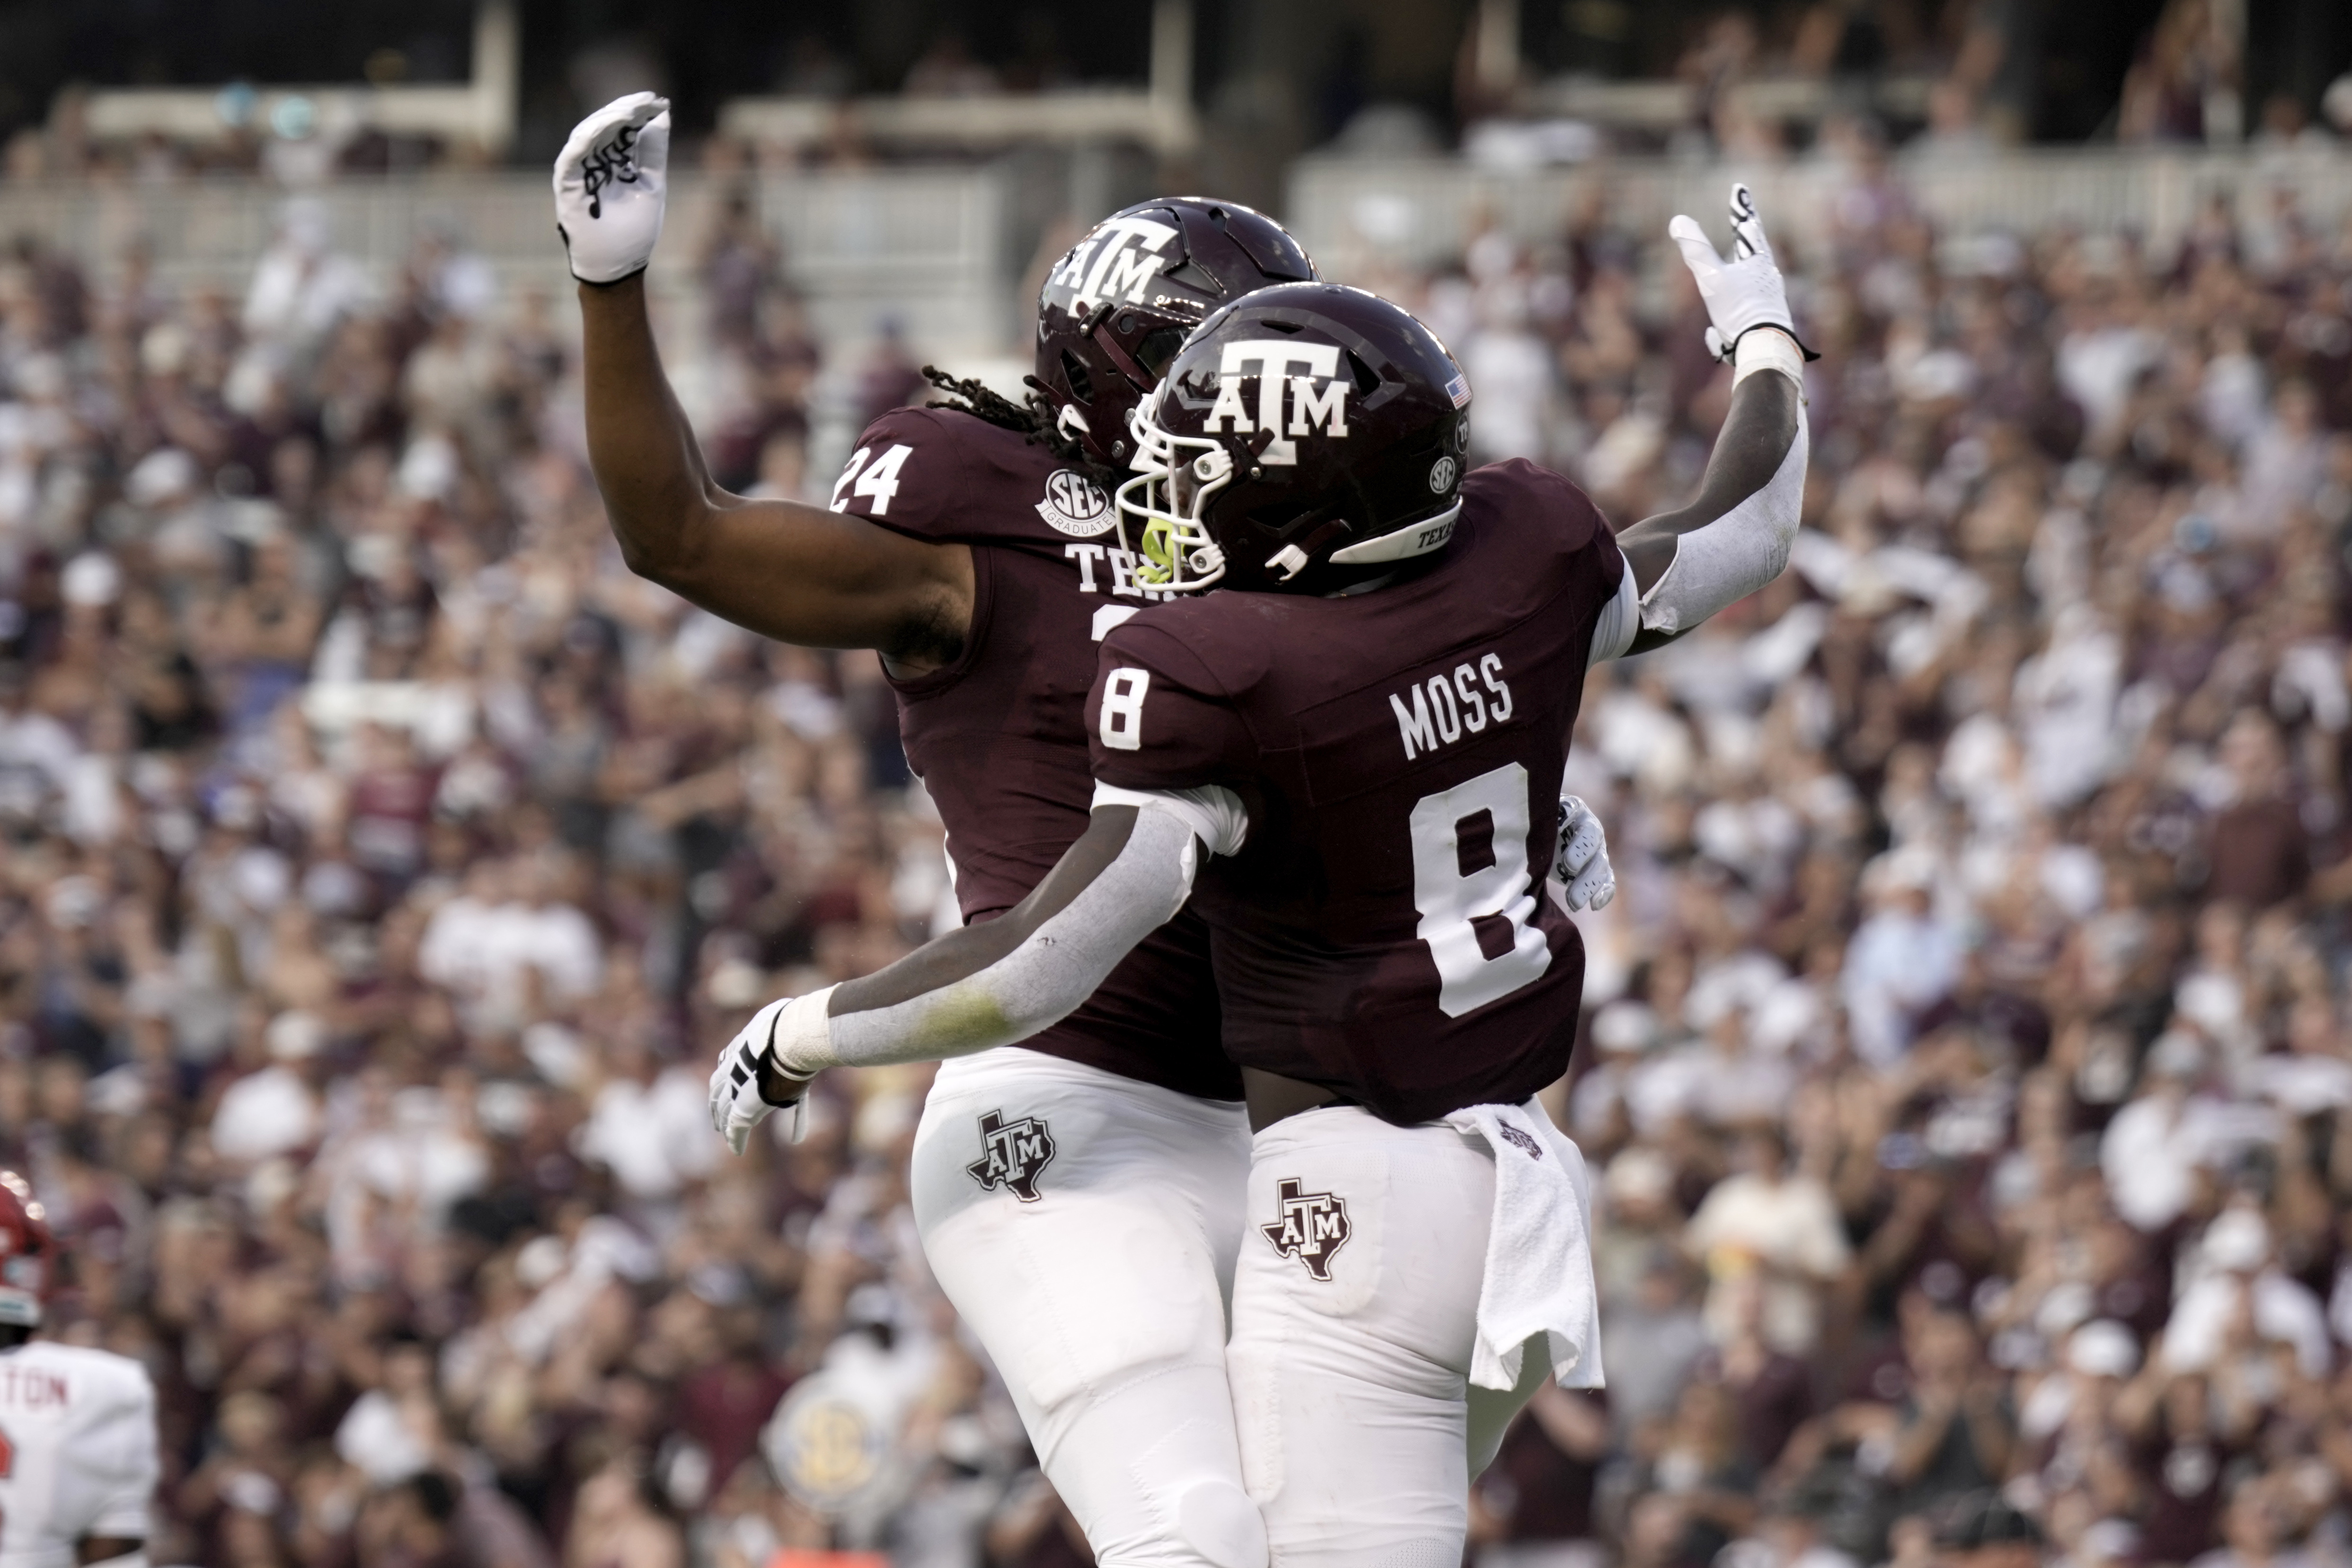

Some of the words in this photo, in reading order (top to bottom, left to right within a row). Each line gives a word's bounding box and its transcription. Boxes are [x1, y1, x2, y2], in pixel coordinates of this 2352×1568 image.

[829, 444, 913, 515] 24
[1051, 473, 1103, 518] SEC
[1433, 461, 1453, 489] SEC
[1047, 512, 1113, 535] GRADUATE
[1099, 667, 1149, 750] 8
[1389, 652, 1513, 761] MOSS
[1410, 761, 1552, 1019] 8
